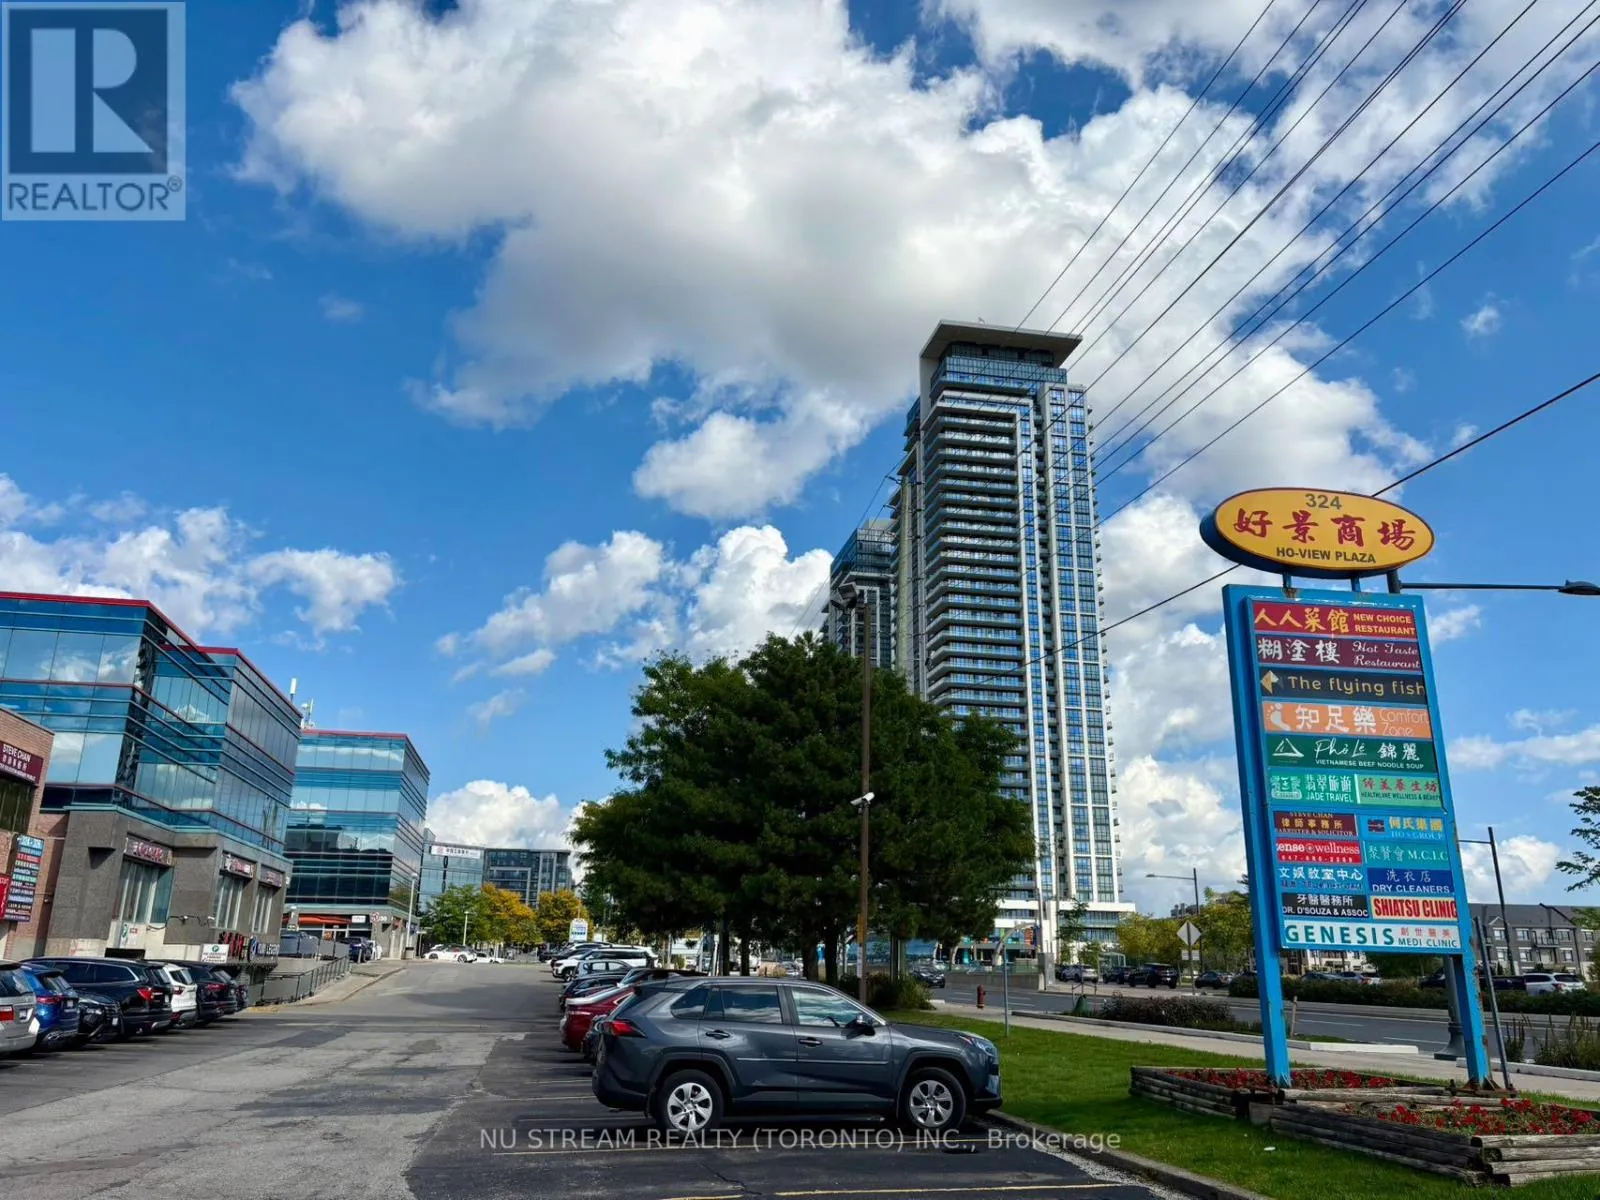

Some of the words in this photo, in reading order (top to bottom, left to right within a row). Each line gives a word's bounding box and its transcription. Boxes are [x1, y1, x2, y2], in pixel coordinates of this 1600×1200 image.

[1305, 493, 1342, 510] 324
[1233, 508, 1416, 551] 好景商場
[1276, 547, 1331, 561] HO-VIEW
[1336, 550, 1376, 564] PLAZA
[1254, 606, 1349, 633] 人人菜館
[1353, 613, 1374, 622] NEW
[1376, 614, 1412, 624] CHOICE
[1355, 624, 1416, 635] RESTAURANT
[1257, 637, 1340, 664] 糊塗樓
[1352, 641, 1378, 653] Hot
[1384, 642, 1418, 655] Taste
[1353, 654, 1420, 669] Restaurant
[1288, 676, 1321, 691] The
[1329, 676, 1384, 697] flying
[1392, 680, 1425, 695] fish
[1295, 704, 1376, 734] 知足樂
[1379, 709, 1429, 725] Comfort
[1381, 721, 1415, 737] Zone
[1315, 759, 1357, 767] VIETNAMESE
[1377, 761, 1405, 769] NOODLE
[1306, 791, 1325, 801] JADE
[1325, 792, 1354, 803] TRAVEL
[1315, 842, 1360, 855] wellness
[1386, 868, 1431, 883] 洗衣店
[1372, 884, 1393, 893] DRY
[1395, 884, 1450, 894] CLEANERS
[1297, 906, 1332, 915] D'SOUZA
[1333, 908, 1339, 916] &
[1341, 909, 1369, 917] ASSOC
[1374, 898, 1420, 917] SHIATSU
[1422, 899, 1458, 919] CLINIC
[1285, 925, 1394, 946] GENESIS
[1398, 937, 1422, 946] MEDI
[1426, 939, 1457, 948] CLINIC
